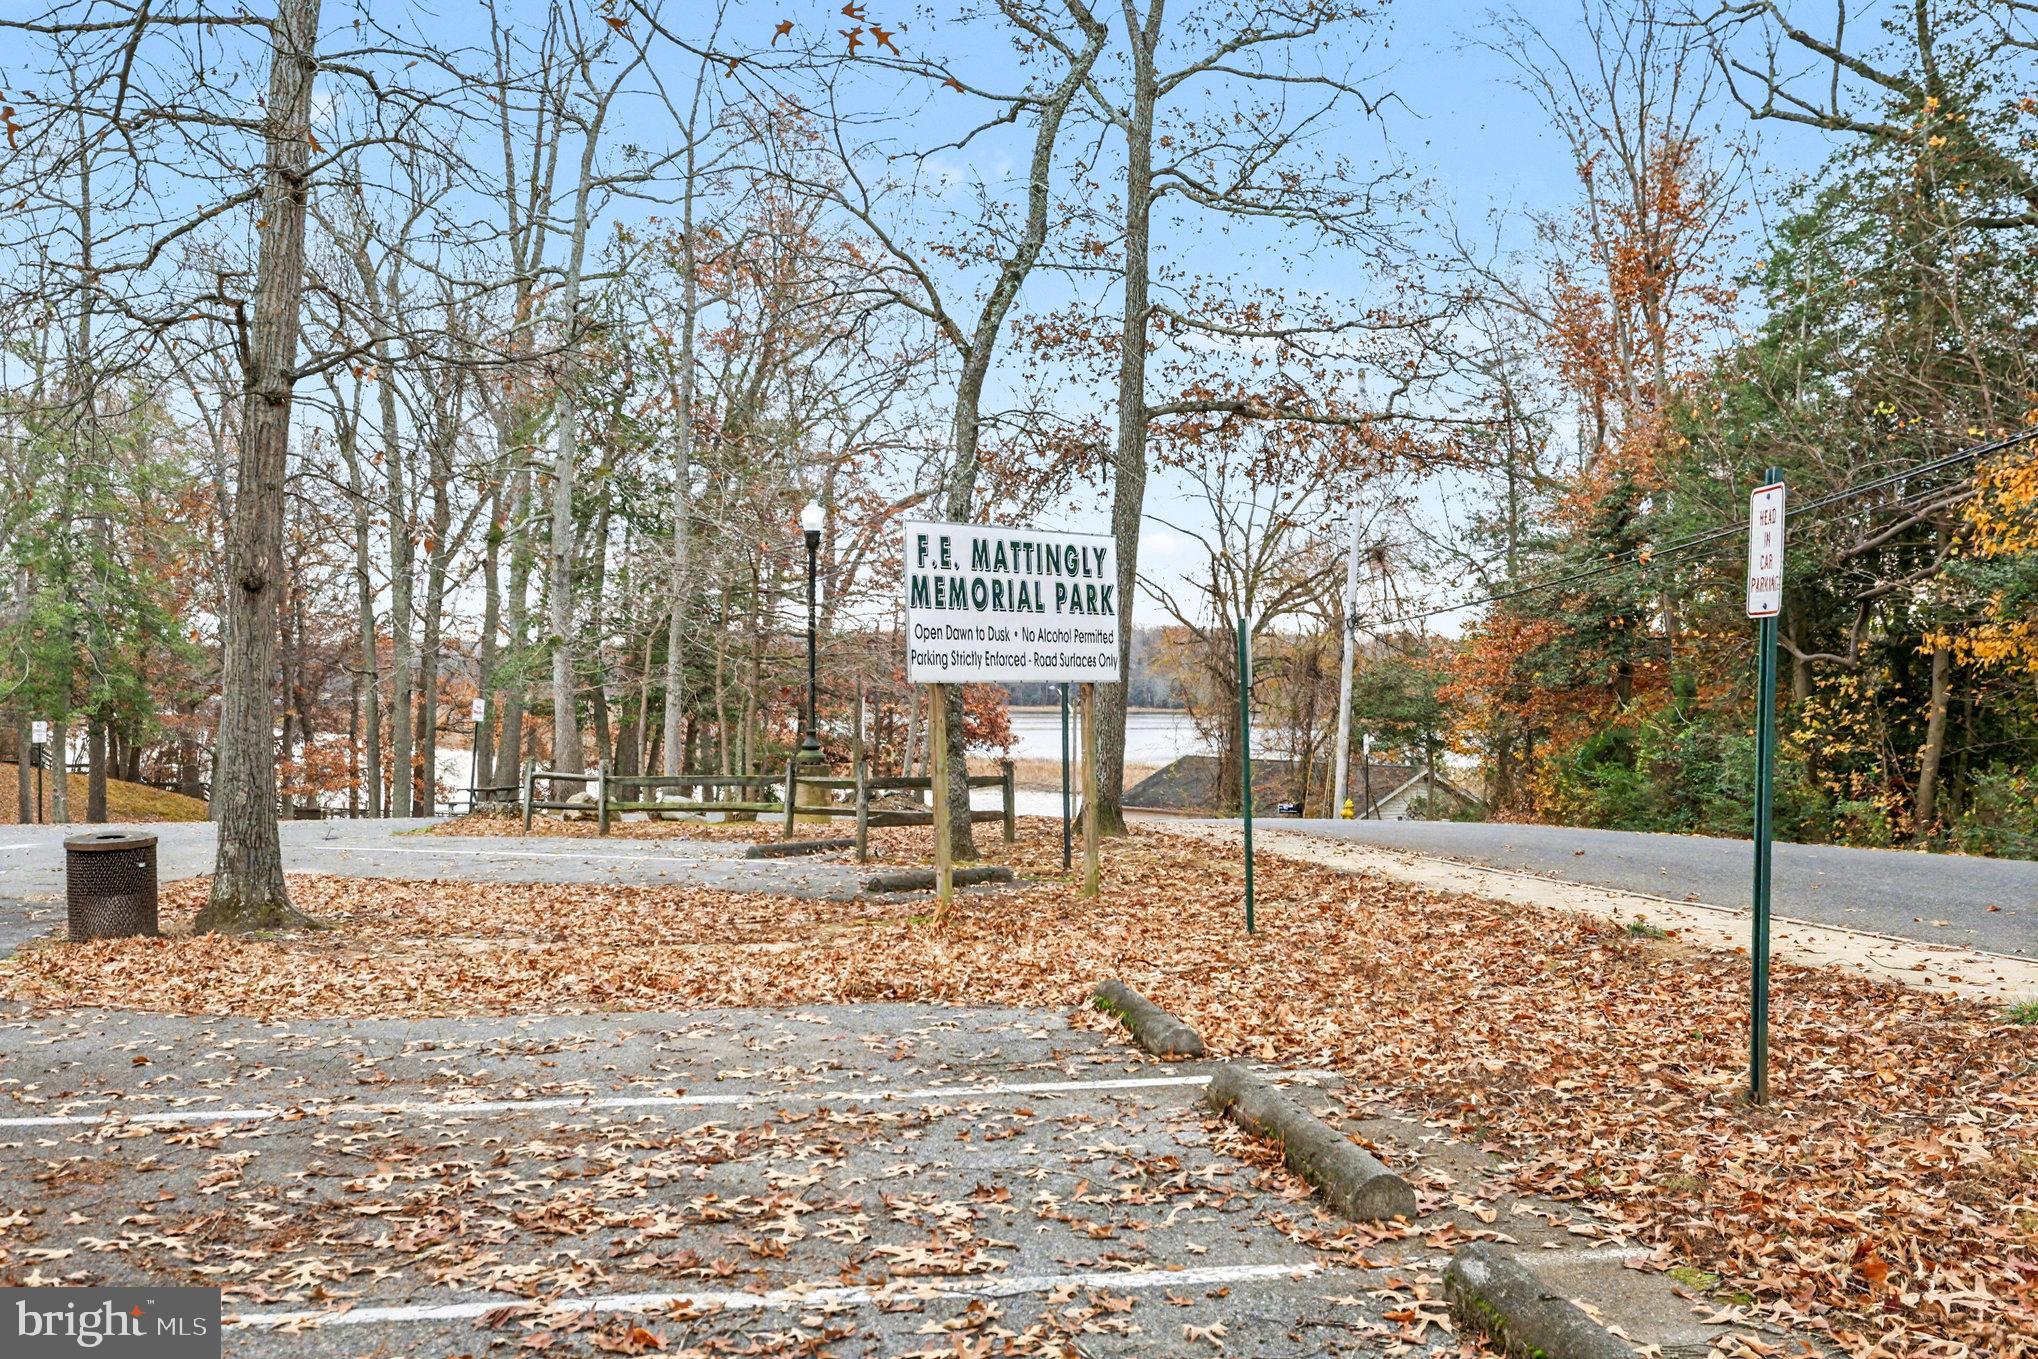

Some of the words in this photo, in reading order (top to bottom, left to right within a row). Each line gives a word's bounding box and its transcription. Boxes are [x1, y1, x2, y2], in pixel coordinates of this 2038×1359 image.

[1760, 508, 1777, 526] HEAD
[1764, 532, 1771, 547] IN
[917, 533, 960, 570] F.E.
[971, 538, 1107, 578] MATTINGLY
[1760, 553, 1773, 570] CAR
[1751, 575, 1780, 592] PARKING
[910, 574, 1046, 613] MEMORIAL
[1055, 581, 1115, 615] PARK
[914, 623, 942, 643] Open
[946, 624, 973, 641] Dawn
[976, 626, 985, 641] to
[988, 626, 1010, 641] Dusk
[1022, 627, 1035, 642] No
[1038, 627, 1072, 643] Alcohol
[1074, 628, 1114, 644] Permitted
[911, 649, 948, 670] Parking
[951, 650, 982, 669] Strictly
[985, 651, 1026, 667] Enforced
[1033, 652, 1057, 667] Road
[1059, 652, 1096, 668] Surfaces
[1098, 653, 1119, 671] Only
